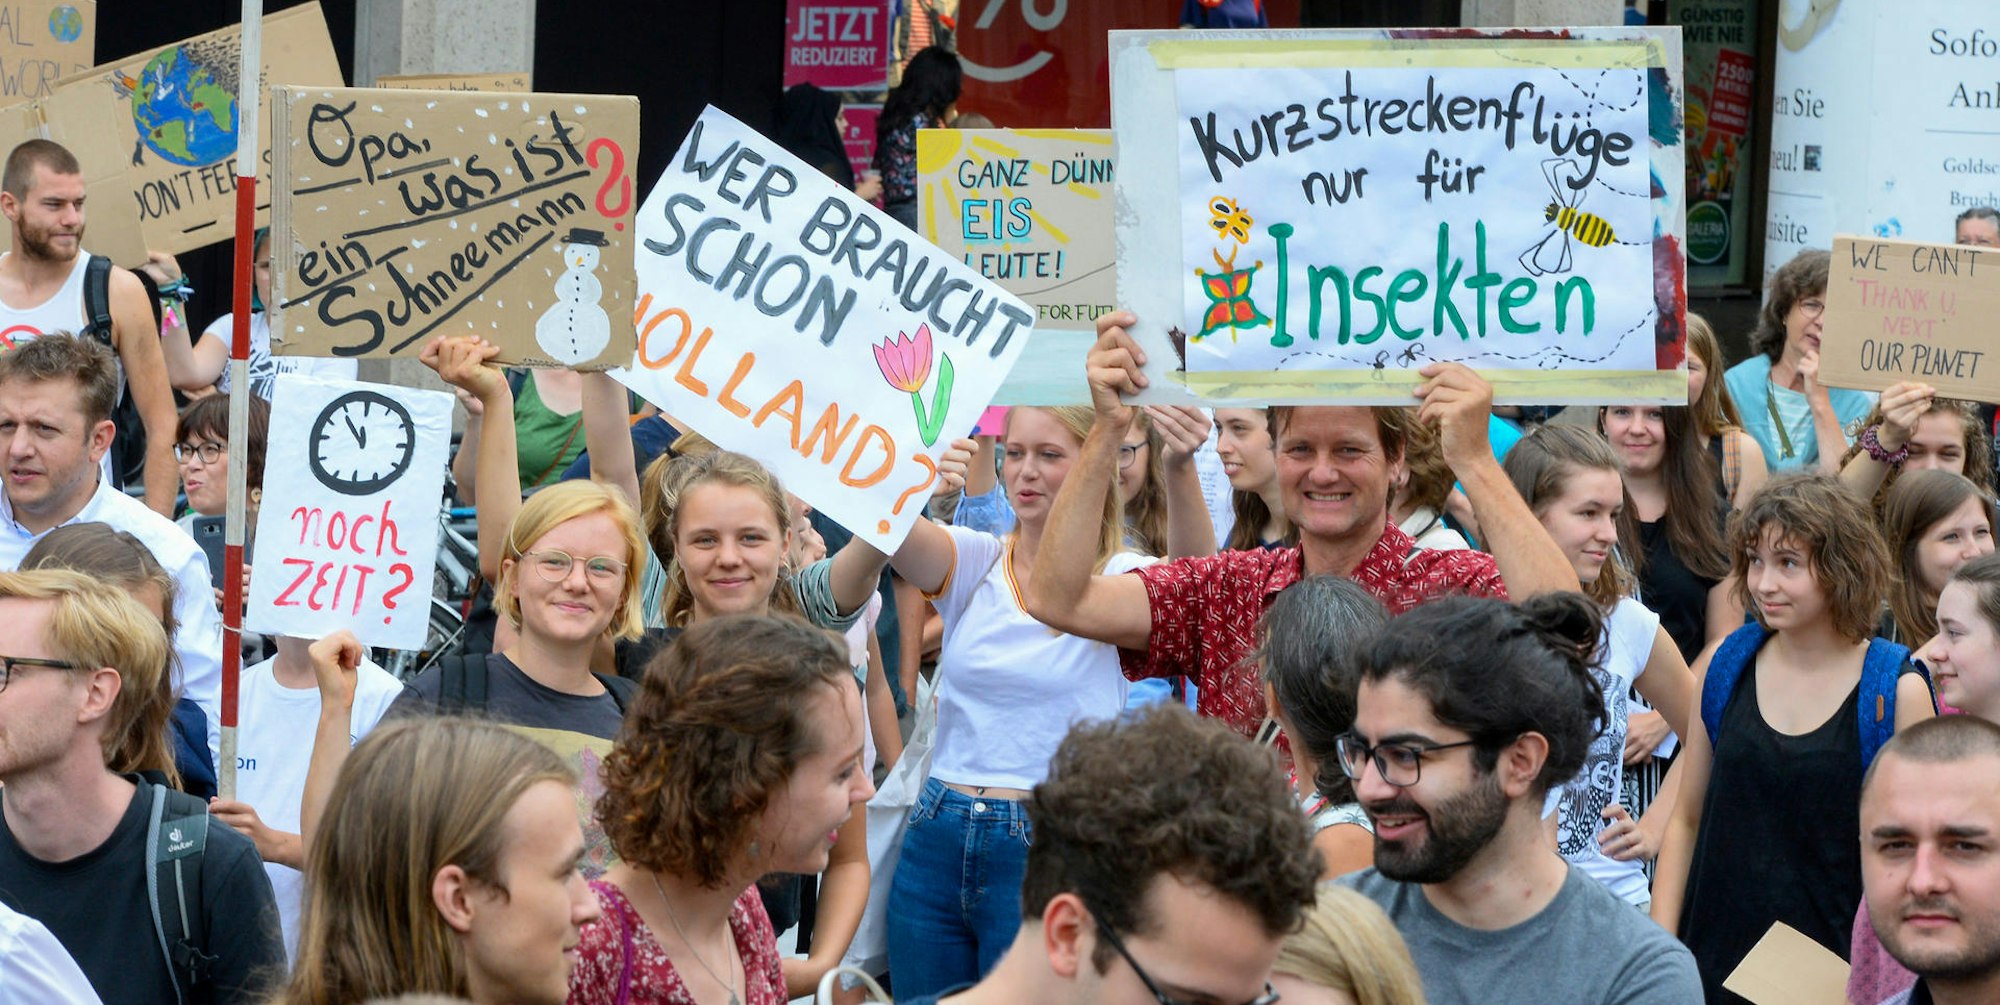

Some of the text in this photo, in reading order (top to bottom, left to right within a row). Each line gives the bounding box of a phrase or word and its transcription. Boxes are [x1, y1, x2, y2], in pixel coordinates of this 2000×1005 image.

[792, 8, 878, 41] JETZT
[1718, 27, 1744, 42] NIE
[790, 48, 876, 66] REDUZIERT
[1793, 88, 1824, 118] Sie
[308, 101, 431, 186] Opa,
[1190, 69, 1634, 191] Kurzstreckenflüge
[399, 153, 501, 216] was
[503, 110, 584, 184] ist
[959, 160, 1030, 188] GANZ
[1302, 150, 1484, 207] nur für
[683, 120, 1034, 359] WER BRAUCHT
[962, 197, 1032, 240] EIS
[298, 240, 373, 287] ein
[317, 191, 586, 357] Schneemann
[643, 192, 858, 347] SCHON
[1268, 219, 1595, 347] Insekten
[1851, 242, 1982, 276] WE CAN'T
[1036, 304, 1113, 322] FOR FUT
[1860, 339, 1984, 379] OUR PLANET
[291, 500, 408, 558] noch
[273, 557, 414, 625] ZEIT?
